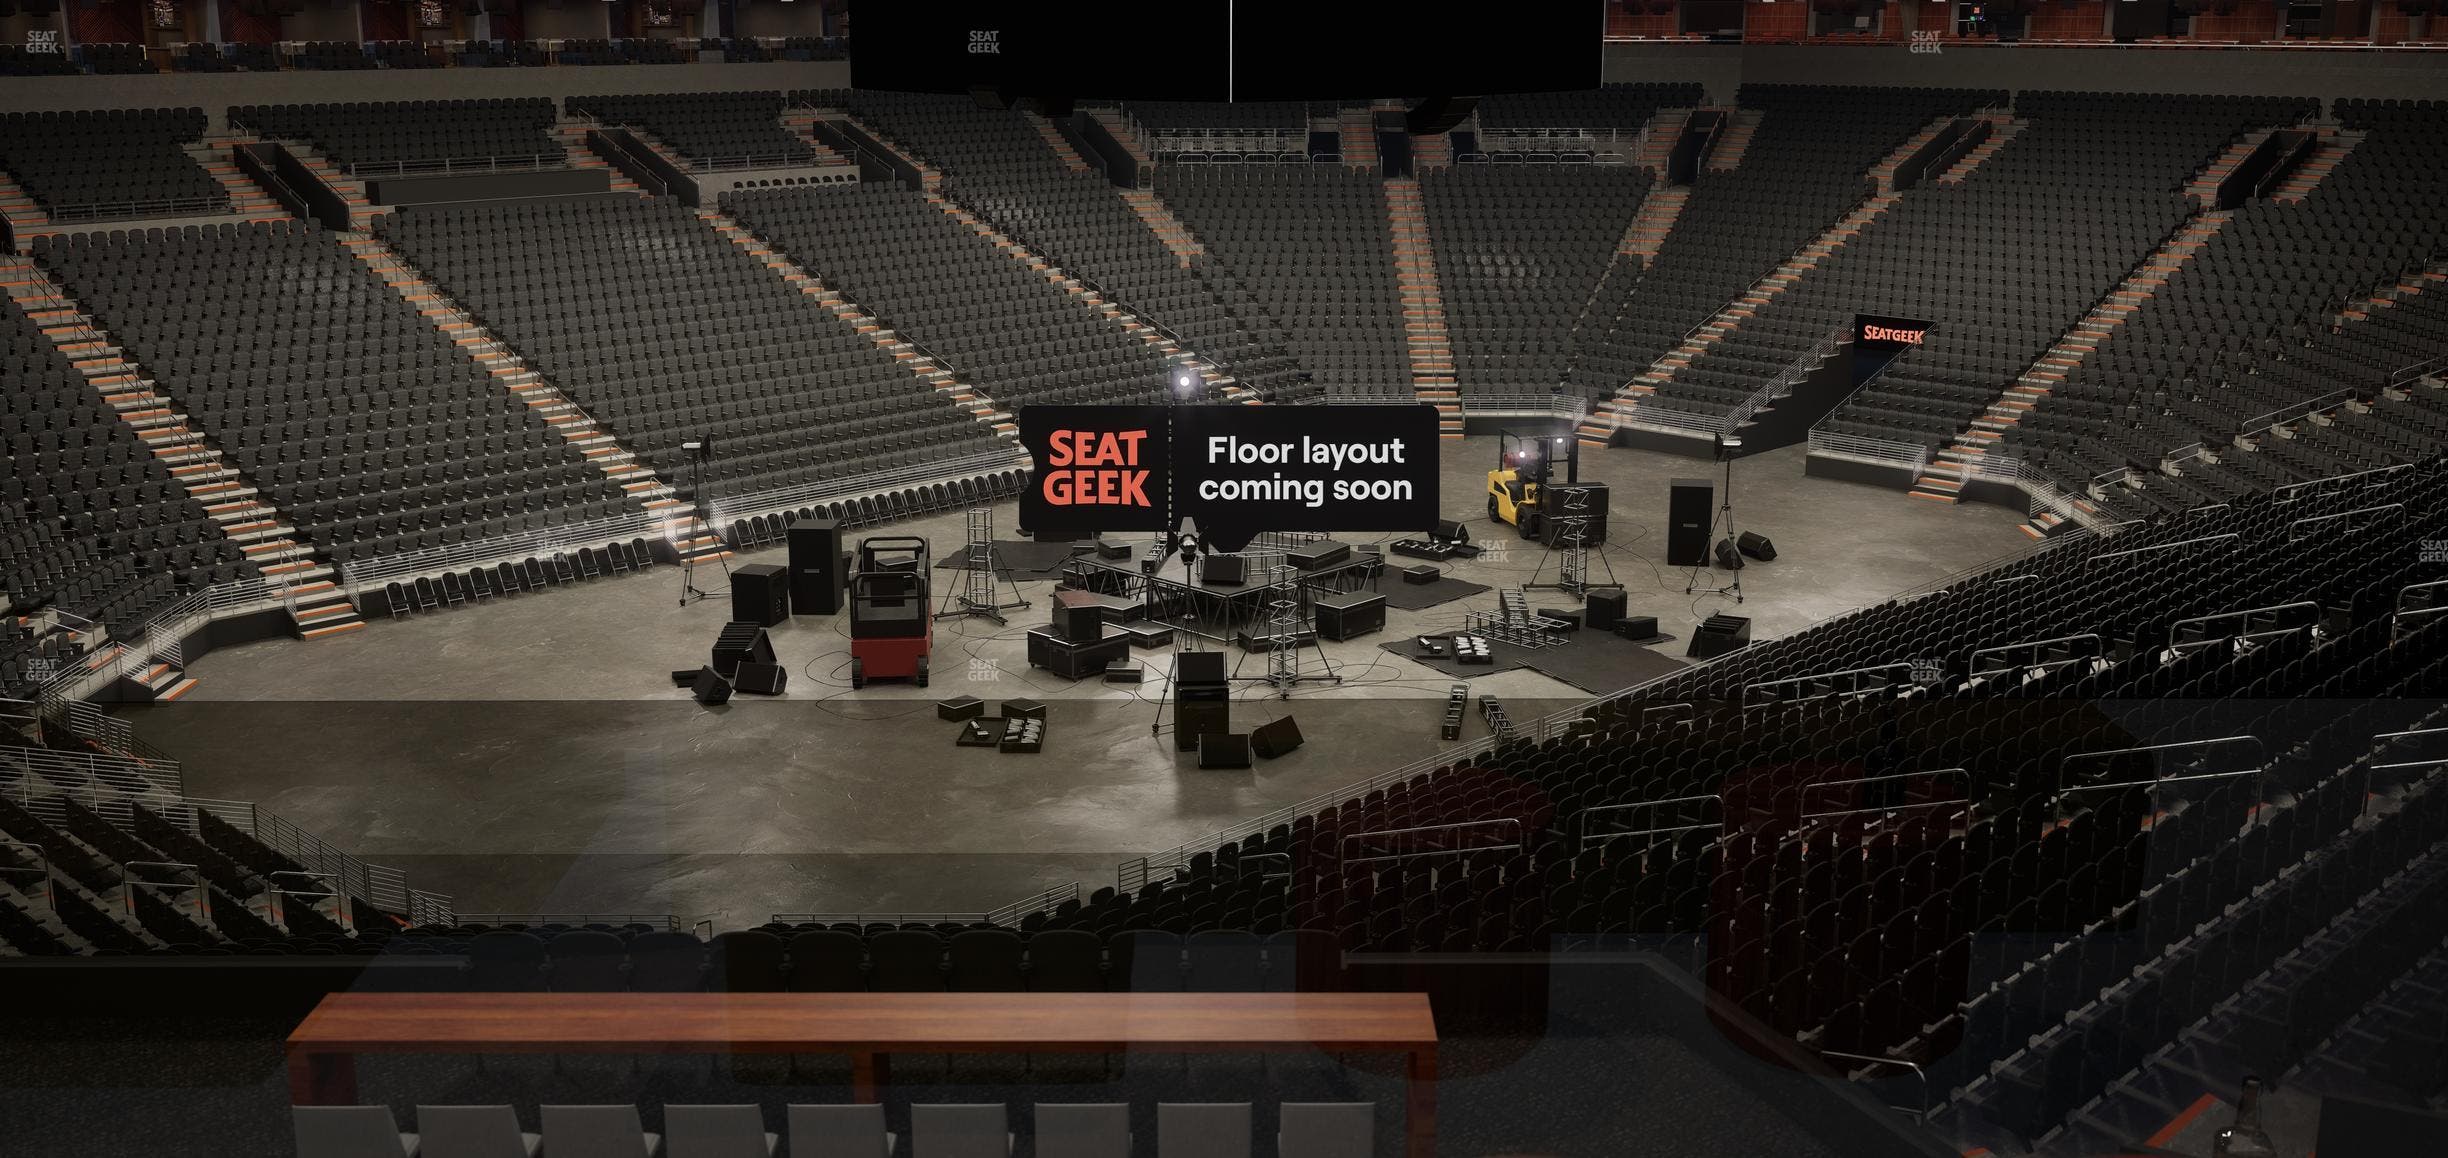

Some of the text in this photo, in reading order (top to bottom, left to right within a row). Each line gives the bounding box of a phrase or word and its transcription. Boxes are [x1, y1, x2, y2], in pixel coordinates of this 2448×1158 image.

[1864, 325, 1925, 345] SEATGEEK
[1049, 429, 1148, 468] SEAT
[1208, 436, 1405, 470] Floor layout
[1043, 469, 1151, 508] GEEK
[1199, 473, 1413, 508] coming soon
